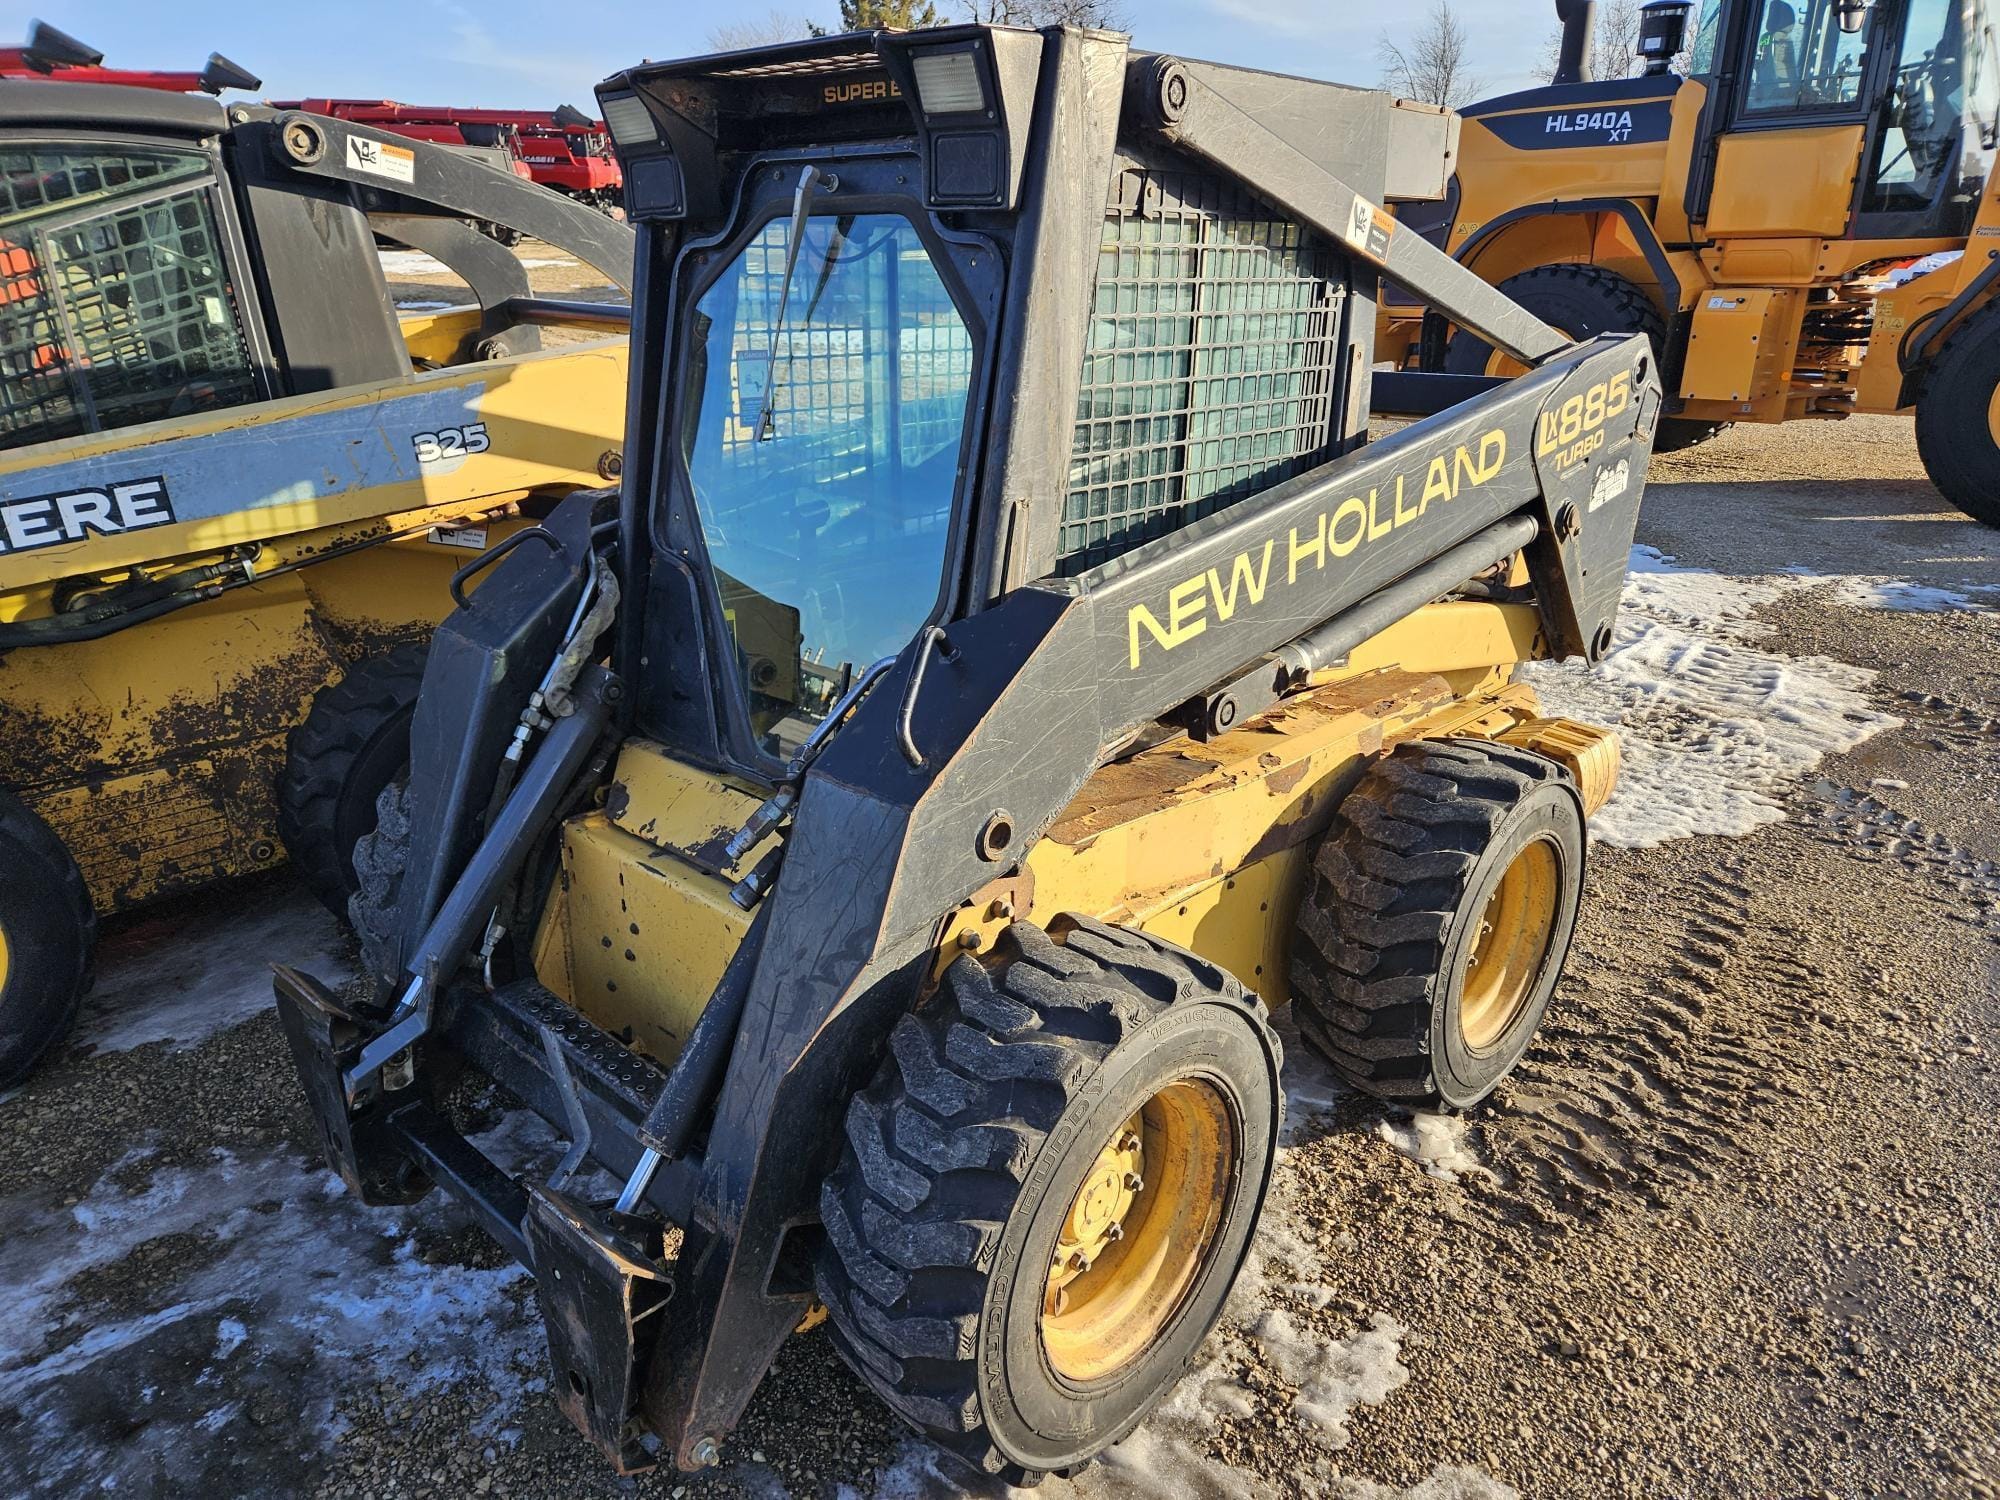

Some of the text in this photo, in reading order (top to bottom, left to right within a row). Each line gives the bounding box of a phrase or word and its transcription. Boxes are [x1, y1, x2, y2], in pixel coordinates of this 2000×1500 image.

[824, 81, 886, 103] SUPER
[1545, 111, 1632, 132] HL940A
[1608, 128, 1632, 142] XT
[411, 422, 491, 463] 325
[1555, 428, 1605, 472] TURBO
[0, 480, 170, 551] ERE
[1128, 428, 1507, 671] NEW HOLLAND
[1018, 1072, 1105, 1216] BUDDY
